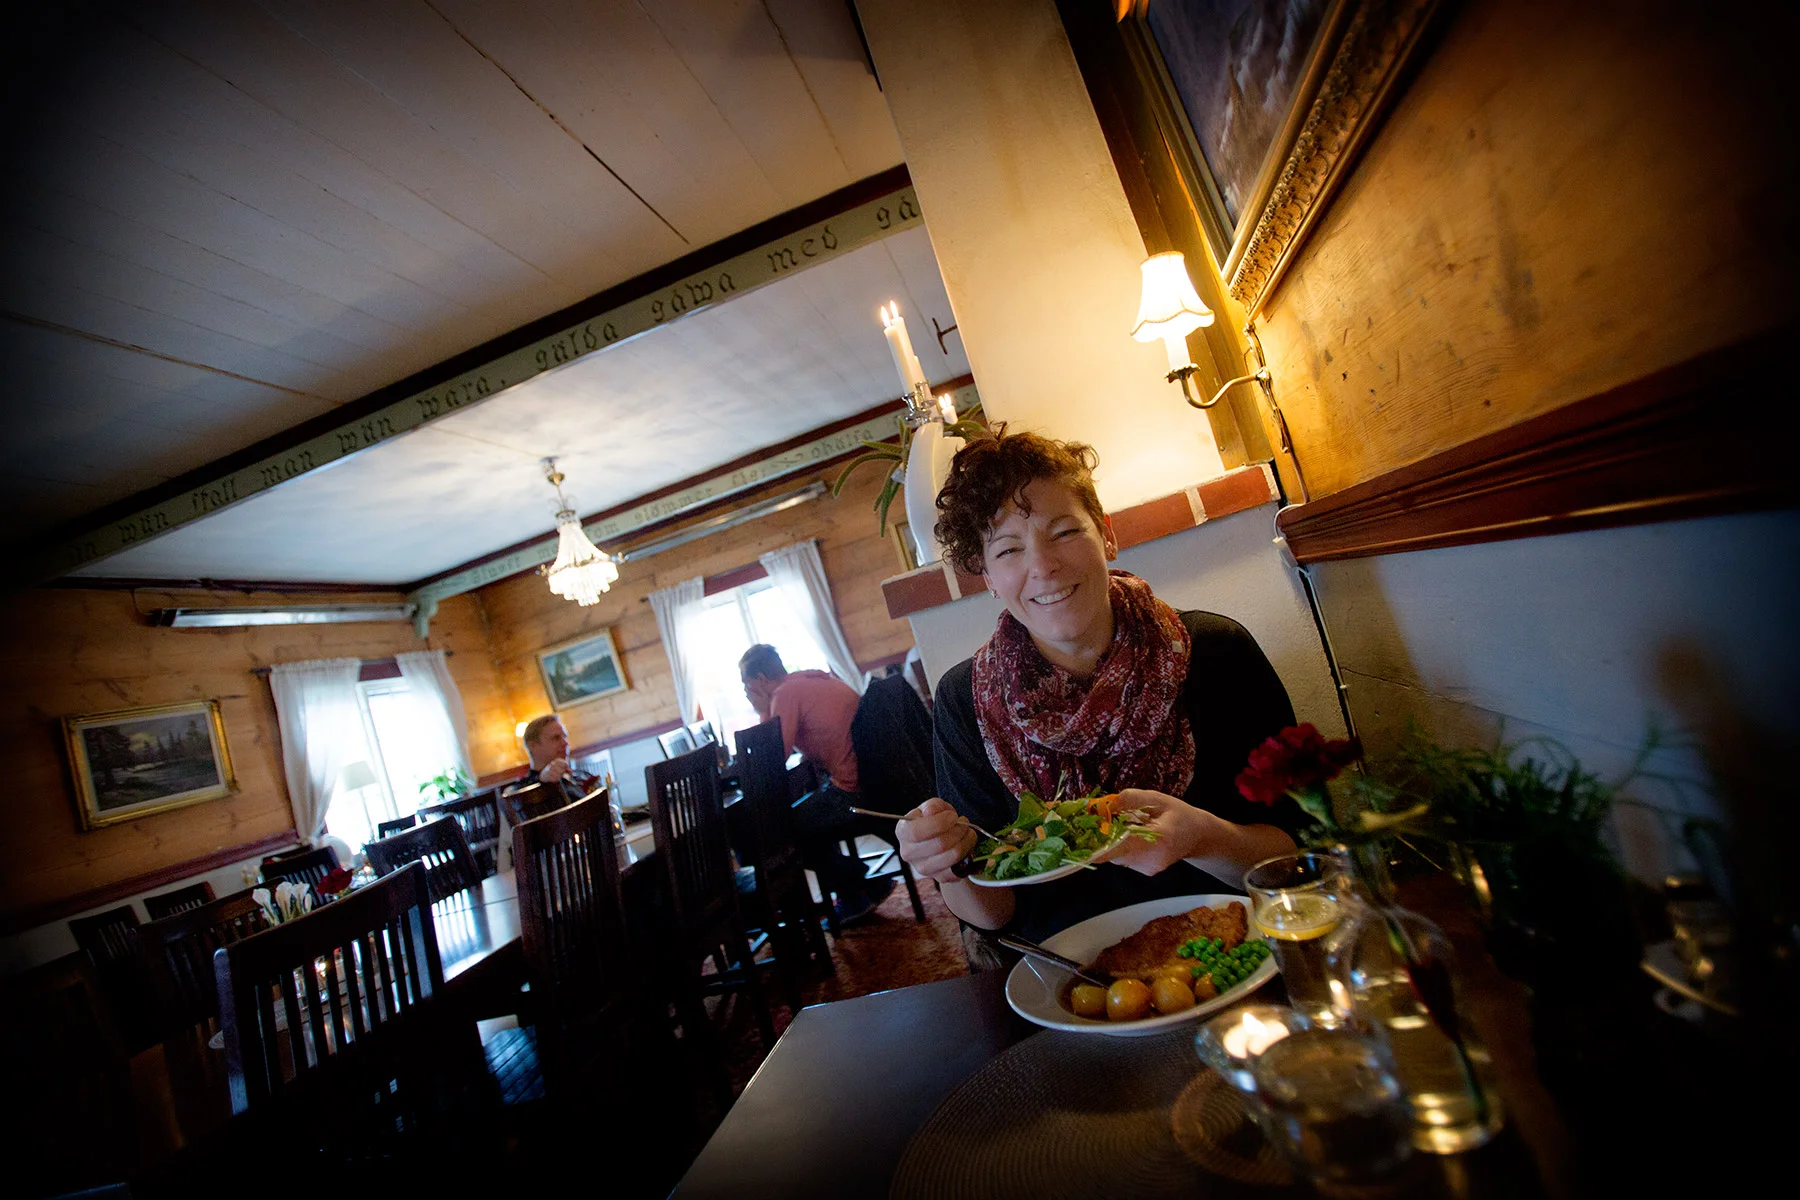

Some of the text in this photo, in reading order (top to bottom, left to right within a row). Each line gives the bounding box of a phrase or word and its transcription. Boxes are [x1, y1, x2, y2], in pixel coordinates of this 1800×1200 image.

[260, 450, 314, 487] man
[767, 224, 839, 273] med
[876, 195, 919, 230] gå
